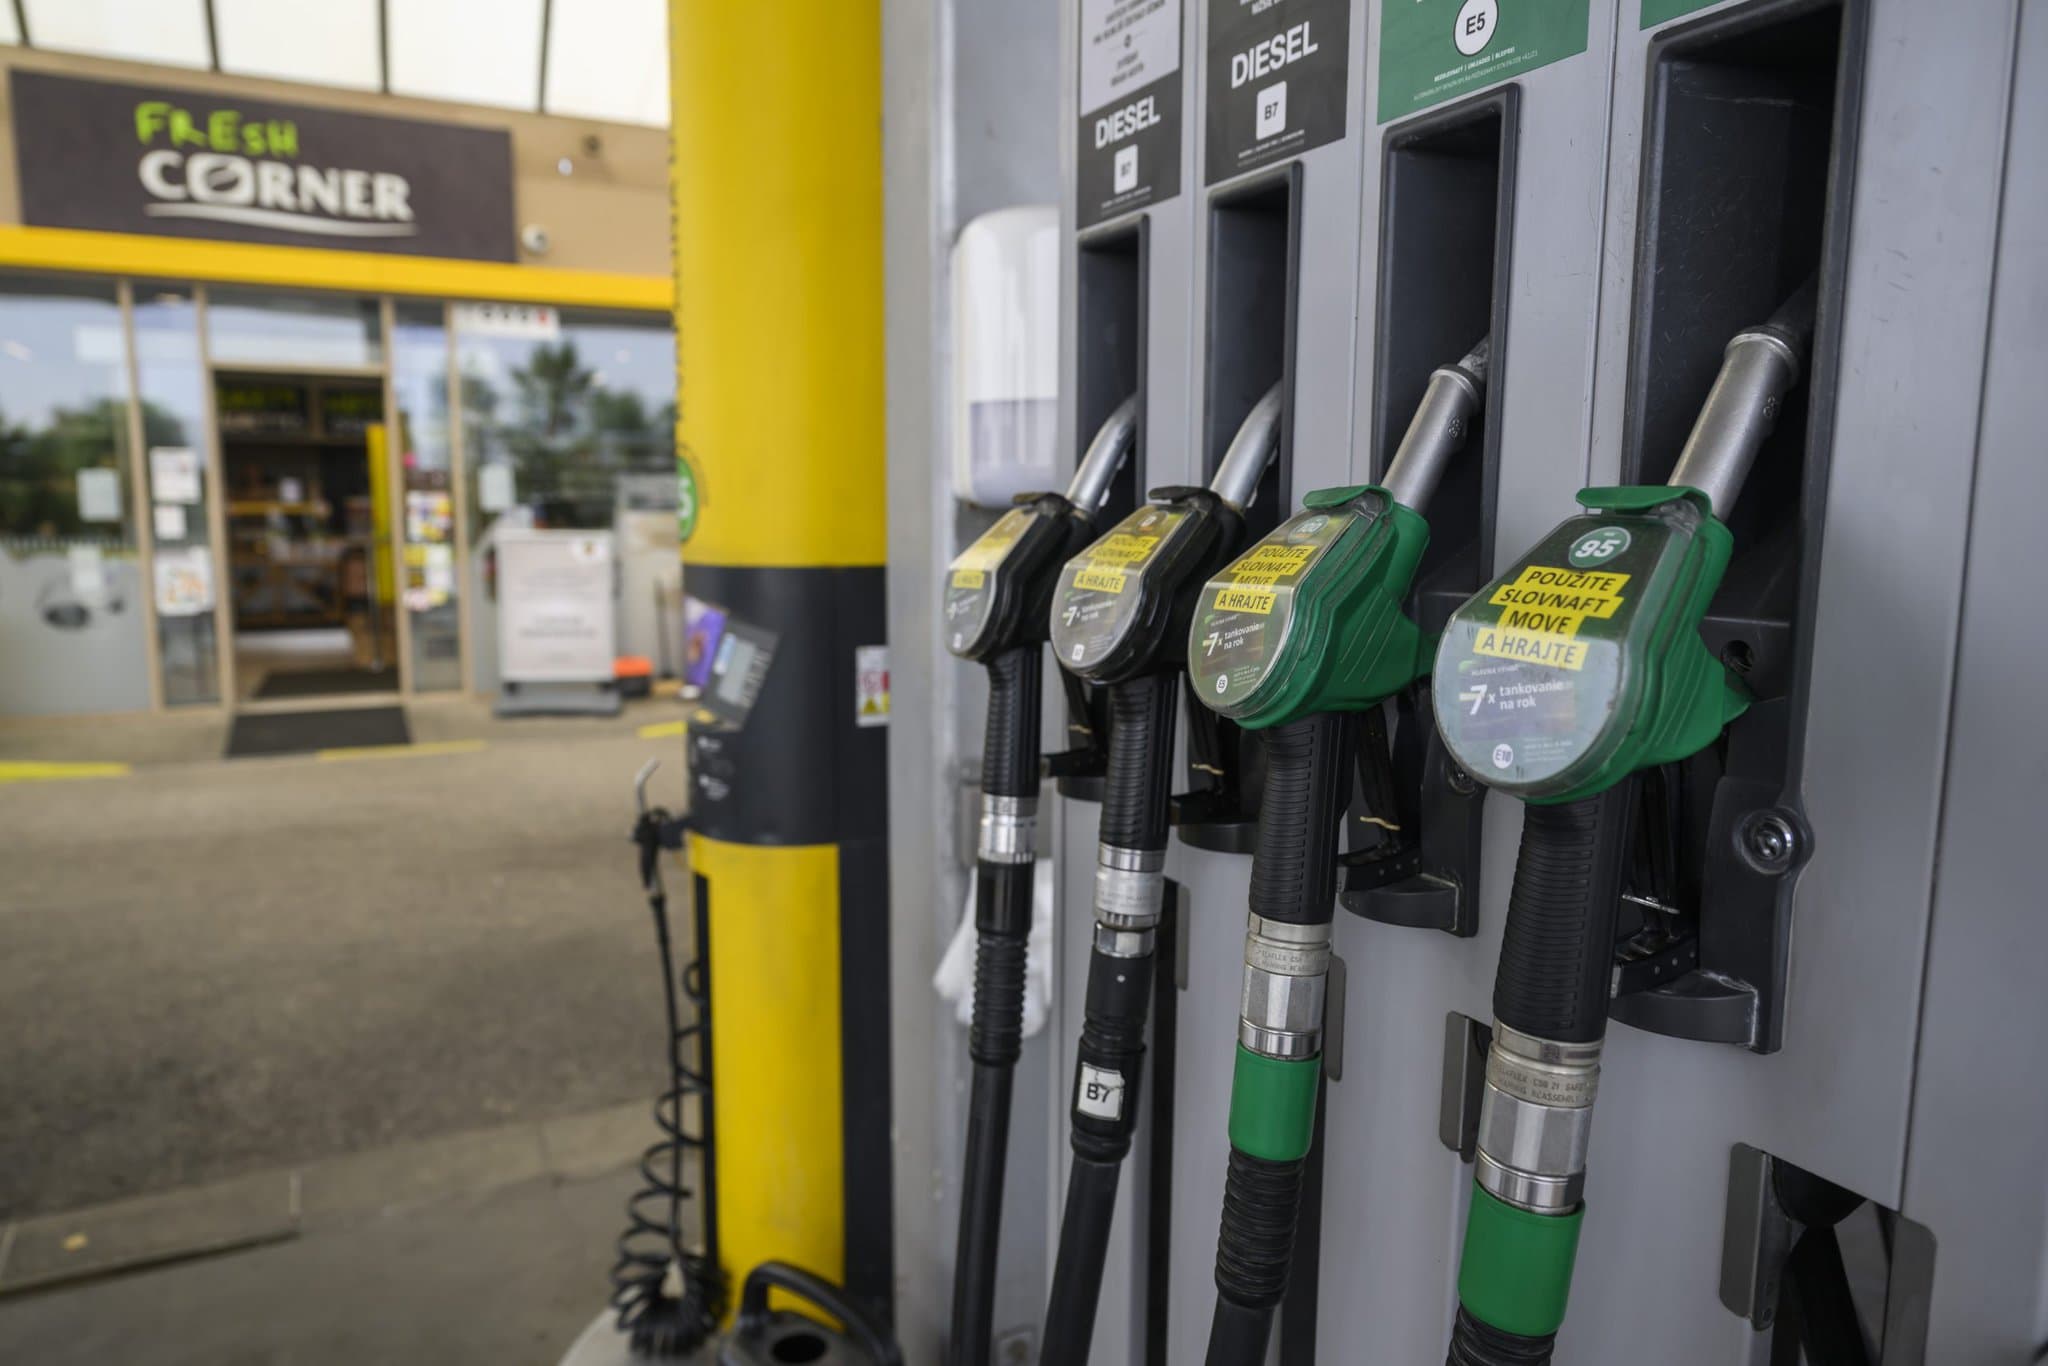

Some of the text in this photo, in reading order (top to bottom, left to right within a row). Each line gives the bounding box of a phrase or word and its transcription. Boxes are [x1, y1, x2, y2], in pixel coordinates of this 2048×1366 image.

[1465, 12, 1486, 36] E5
[1231, 21, 1319, 89] DIESEL
[1264, 102, 1279, 121] B7
[1095, 95, 1161, 149] DIESEL
[138, 149, 416, 221] CORNER
[1575, 539, 1621, 558] 95
[1238, 561, 1299, 574] SLOVNAFT
[1525, 567, 1617, 591] POUŽITE
[1218, 593, 1272, 611] A HRAJTE
[1499, 588, 1611, 613] SLOVNAFT
[1224, 622, 1260, 640] tankovanie
[1507, 610, 1572, 635] MOVE
[1223, 636, 1244, 650] na rok
[1482, 633, 1578, 664] A HRAJTE
[1499, 680, 1564, 697] tankovanie
[1499, 695, 1537, 711] na rok
[1495, 749, 1512, 762] E10
[1087, 1082, 1112, 1103] B7
